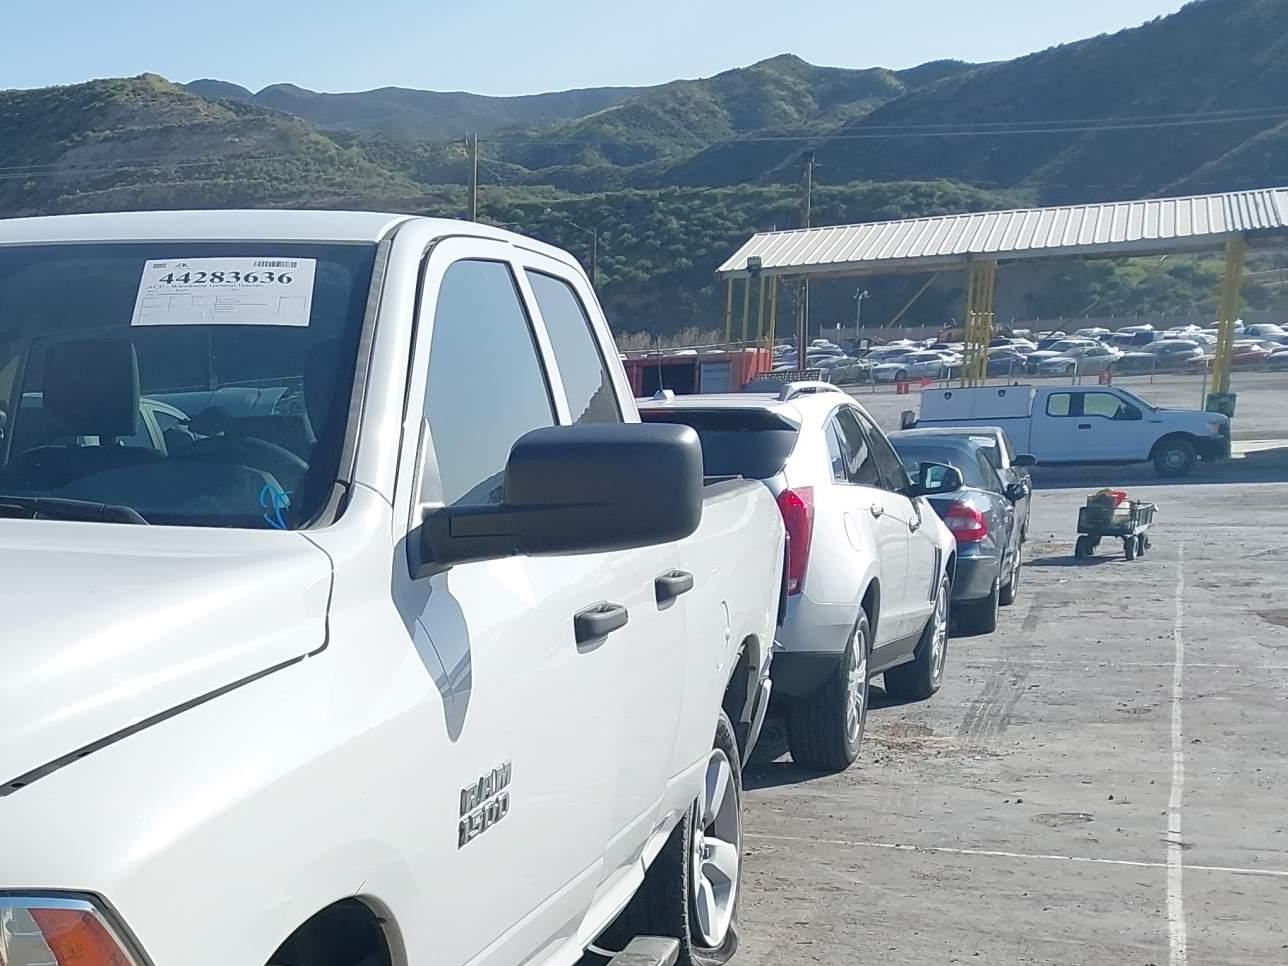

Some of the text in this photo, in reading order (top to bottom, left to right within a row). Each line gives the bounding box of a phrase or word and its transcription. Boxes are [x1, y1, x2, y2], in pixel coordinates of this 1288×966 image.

[159, 271, 293, 284] 44283636
[460, 761, 511, 817] RAM
[457, 791, 511, 849] 1500
